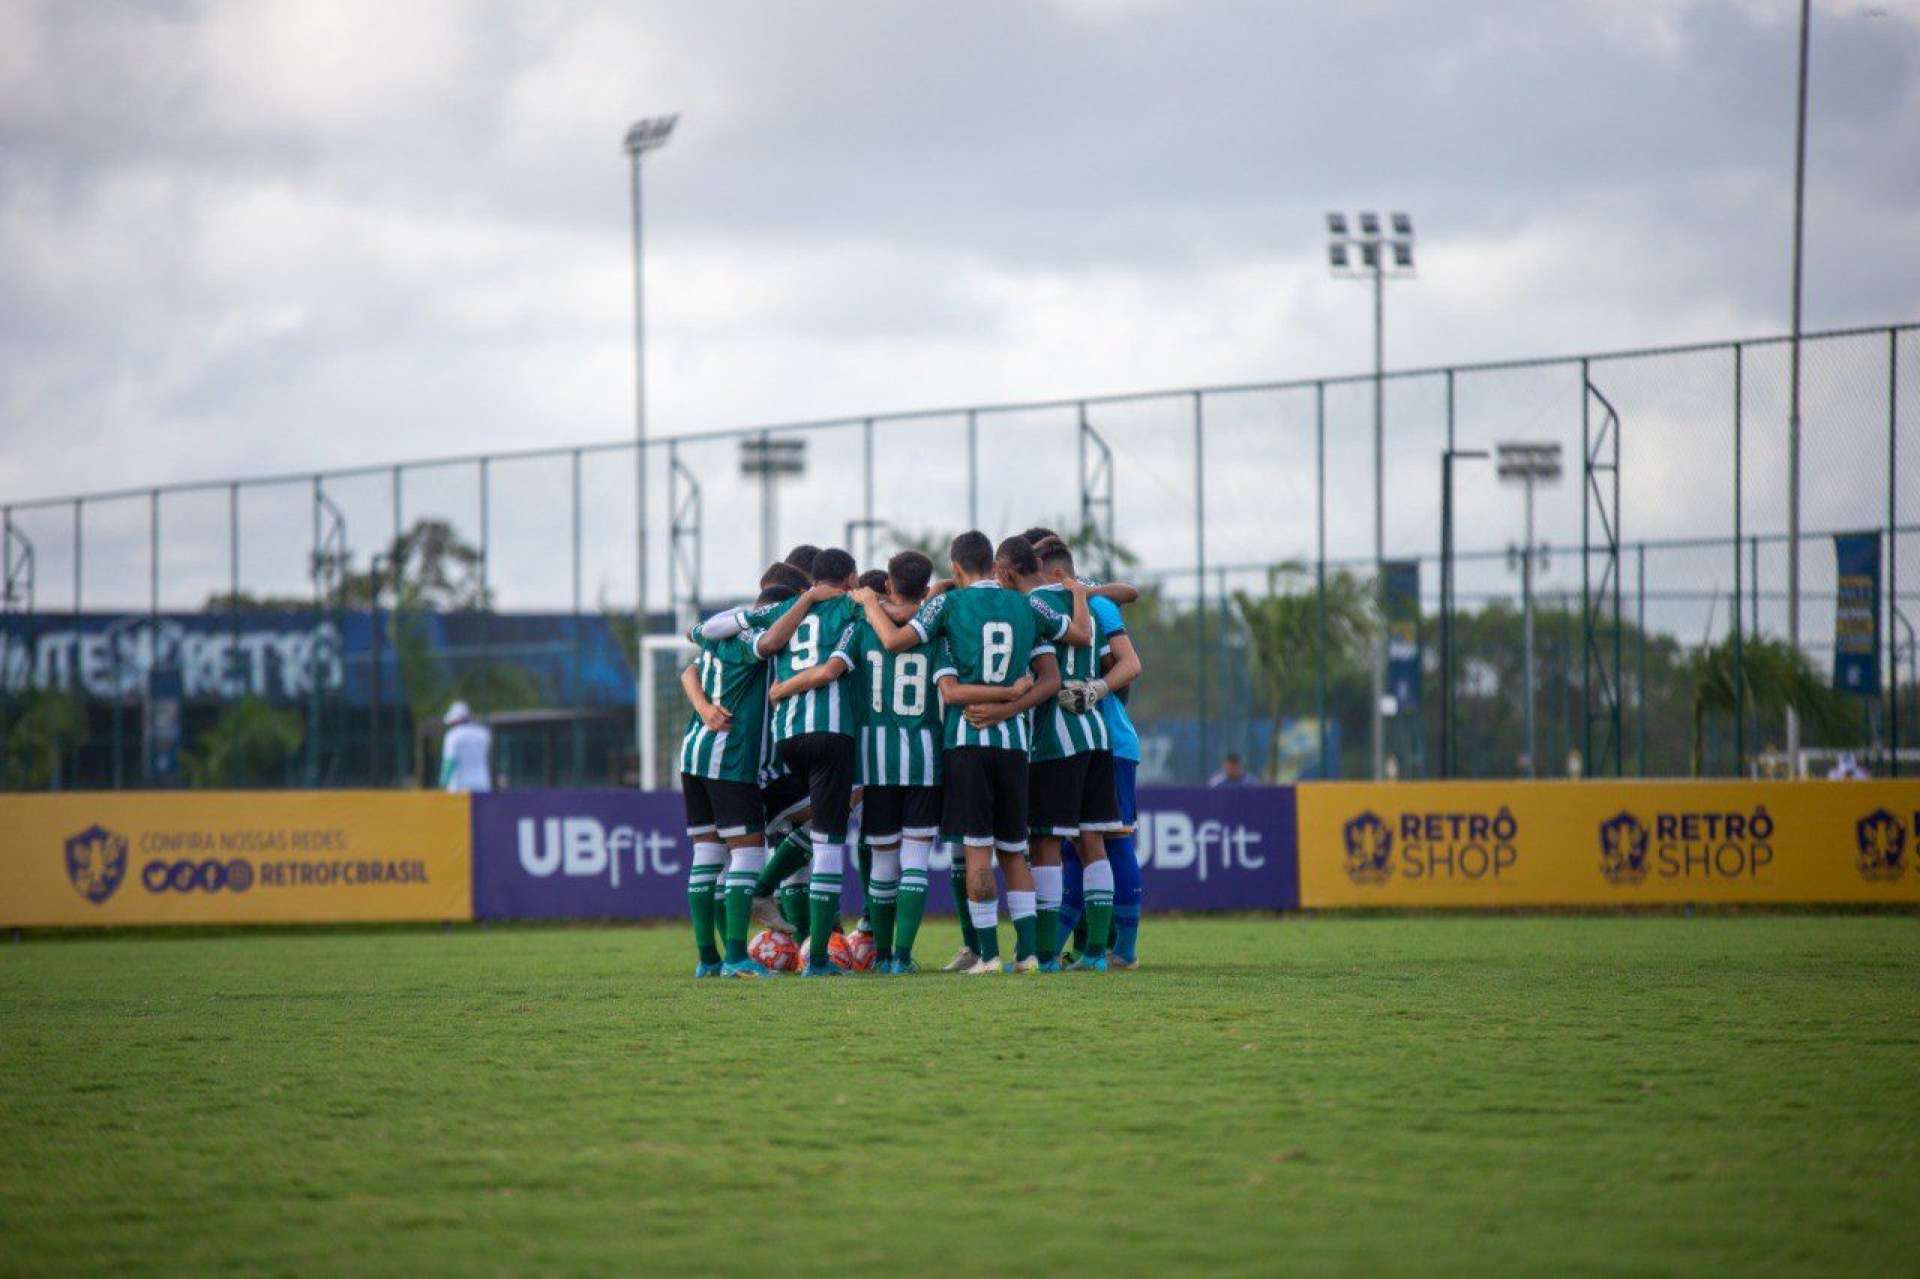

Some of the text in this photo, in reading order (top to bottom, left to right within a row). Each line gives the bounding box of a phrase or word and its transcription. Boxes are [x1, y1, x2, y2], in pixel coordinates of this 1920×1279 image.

[790, 613, 820, 671] 9
[982, 621, 1013, 684] 8
[867, 650, 927, 716] 18
[140, 829, 214, 851] CONFIRA
[220, 830, 286, 851] NOSSAS
[1401, 806, 1517, 841] RETRÔ
[1657, 804, 1773, 840] RETRÔ
[518, 817, 680, 888] UBfit
[1402, 843, 1517, 879] SHOP
[1658, 842, 1773, 878] SHOP
[260, 859, 430, 886] RETROFCBRASIL
